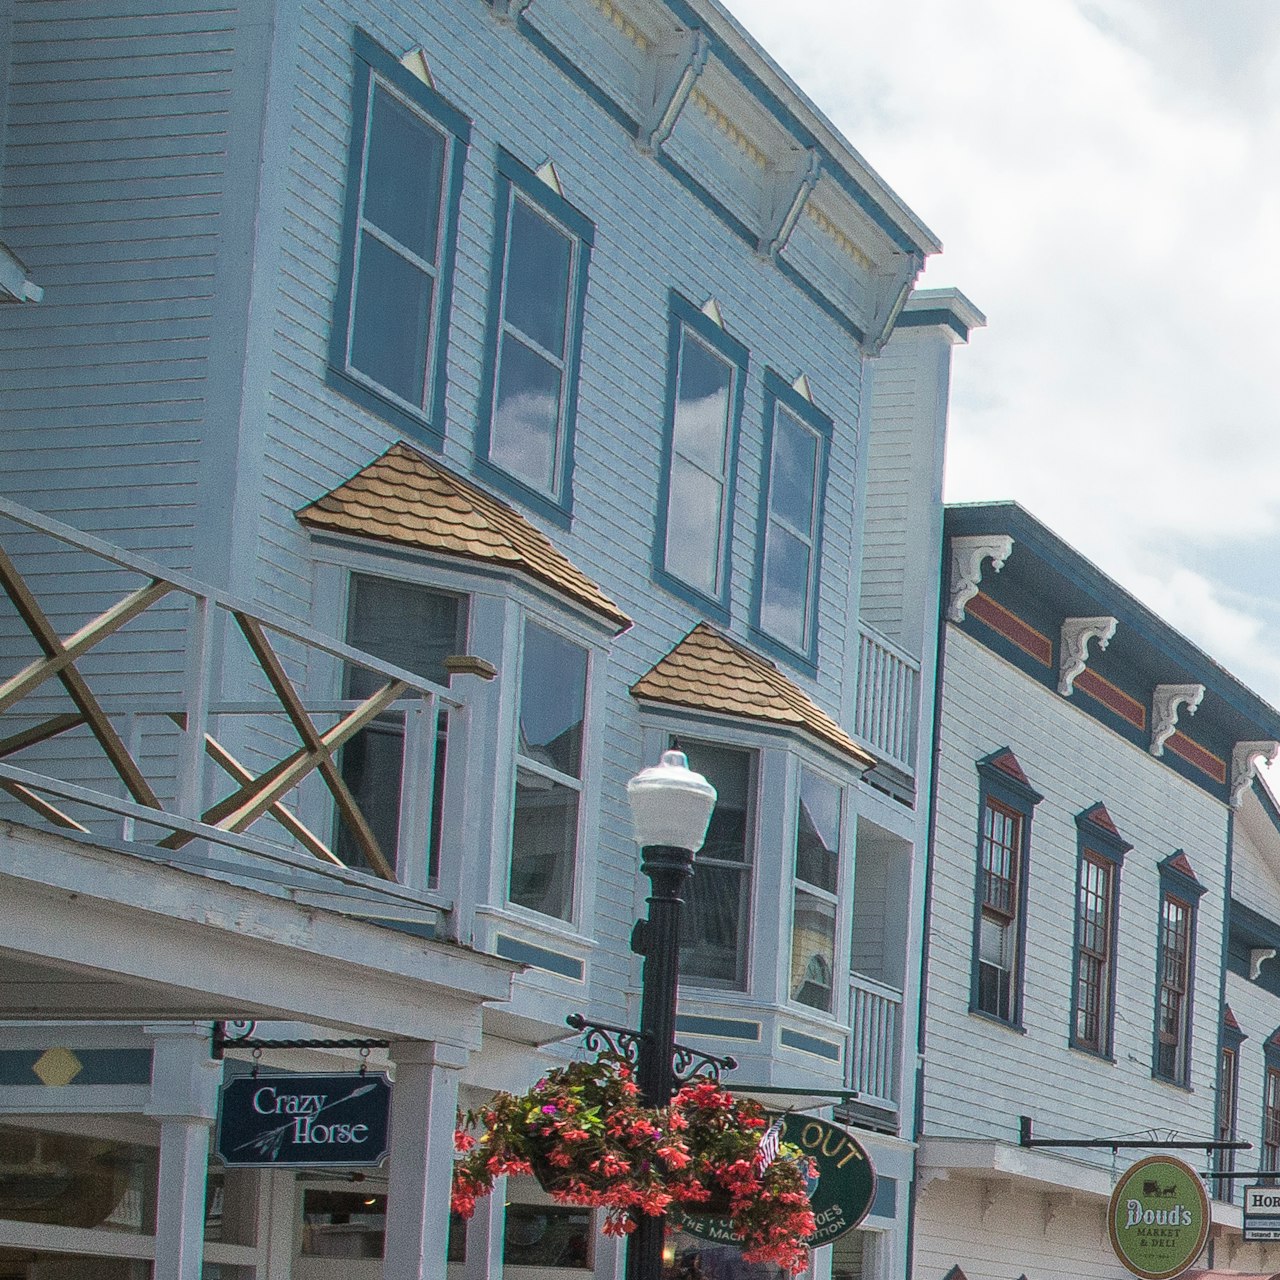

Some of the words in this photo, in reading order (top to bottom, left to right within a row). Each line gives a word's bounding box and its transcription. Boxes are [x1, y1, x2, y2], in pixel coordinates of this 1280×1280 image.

[253, 1086, 328, 1122] Crazy
[292, 1116, 369, 1144] Horse
[801, 1121, 864, 1169] OUT
[680, 1213, 704, 1233] THE
[1124, 1199, 1192, 1230] Doud's
[1136, 1228, 1181, 1238] MARKET
[1140, 1239, 1148, 1247] &
[1151, 1239, 1176, 1248] DELI
[1251, 1230, 1272, 1238] Island
